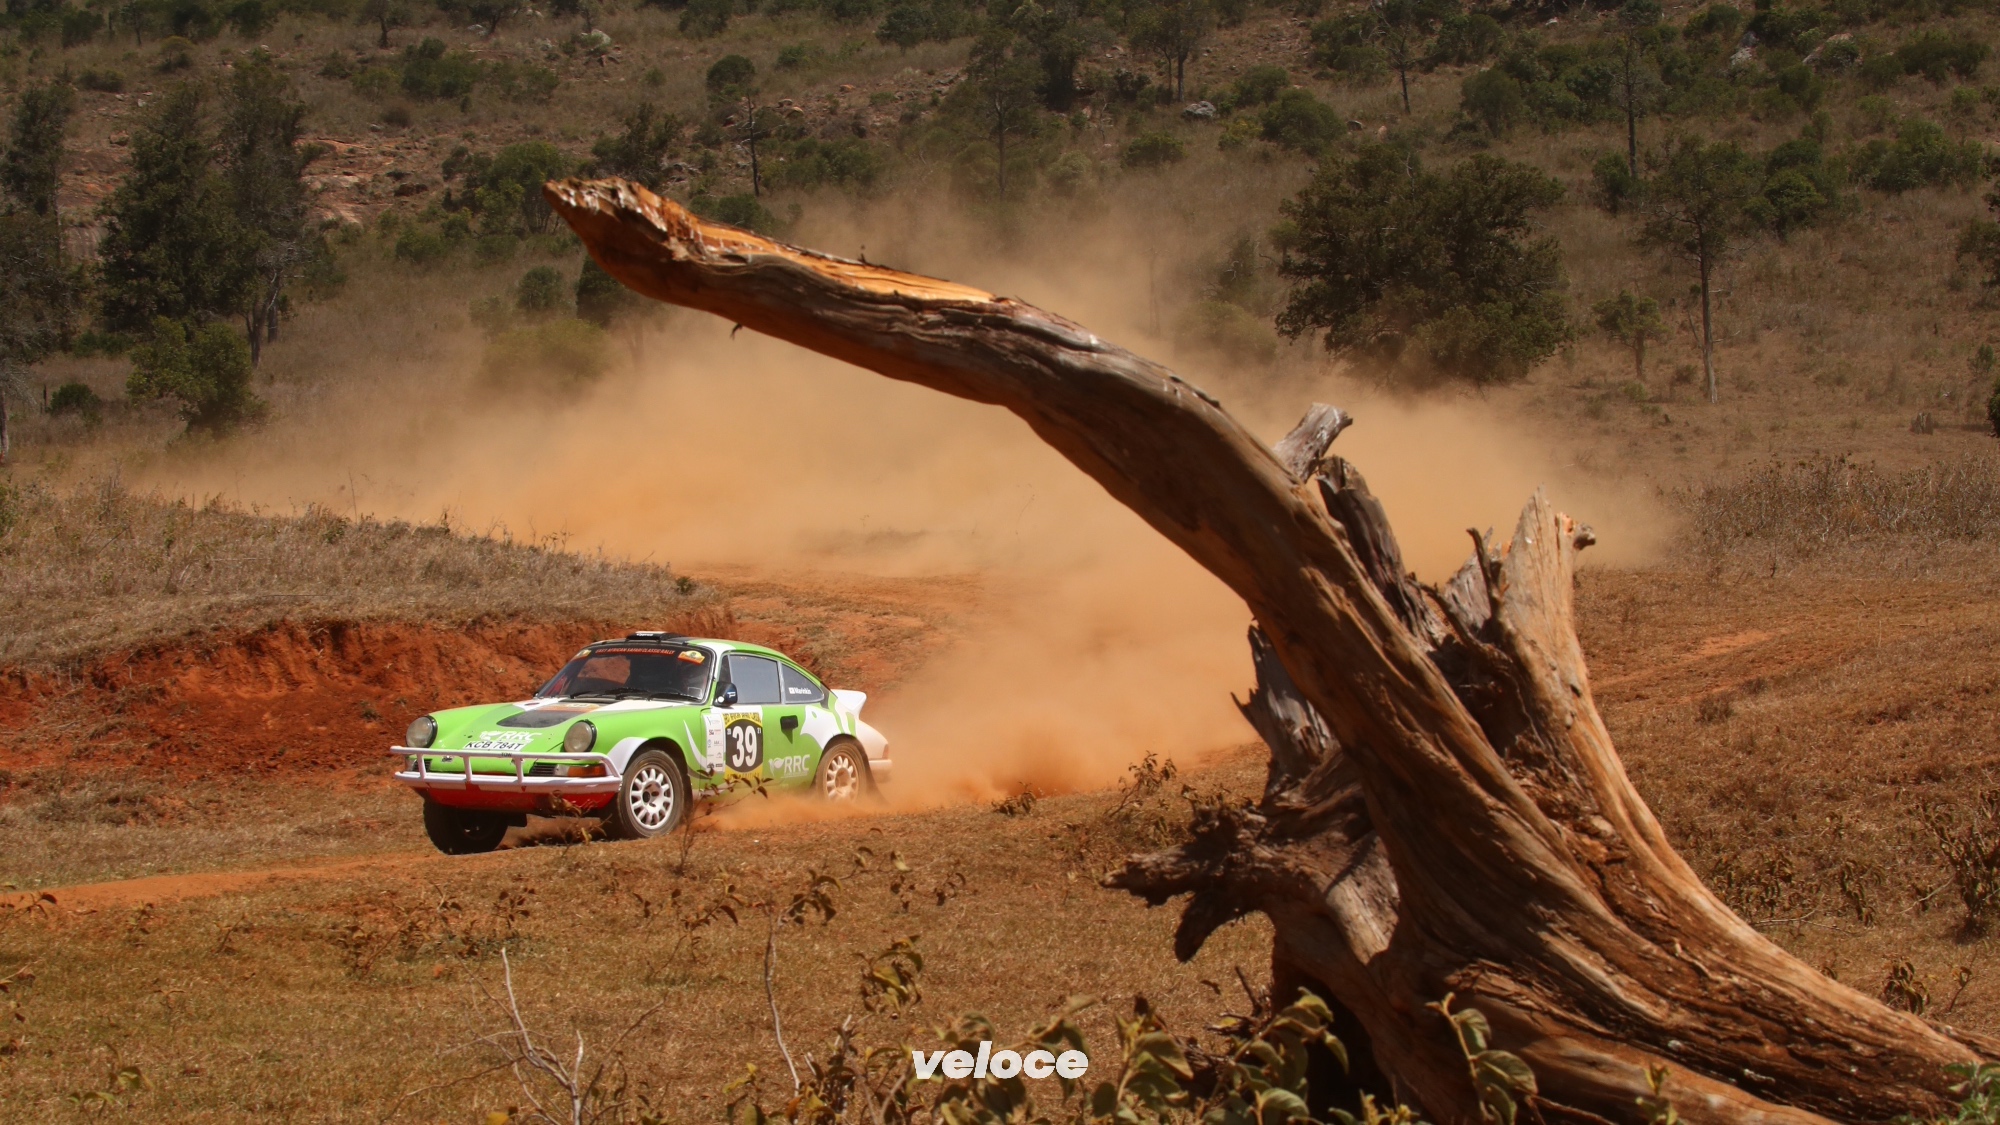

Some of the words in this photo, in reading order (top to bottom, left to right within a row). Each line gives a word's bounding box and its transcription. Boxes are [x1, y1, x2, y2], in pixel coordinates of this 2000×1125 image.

[495, 731, 543, 741] RRC
[493, 742, 524, 750] 784T
[732, 725, 757, 767] 39
[784, 754, 811, 773] RRC
